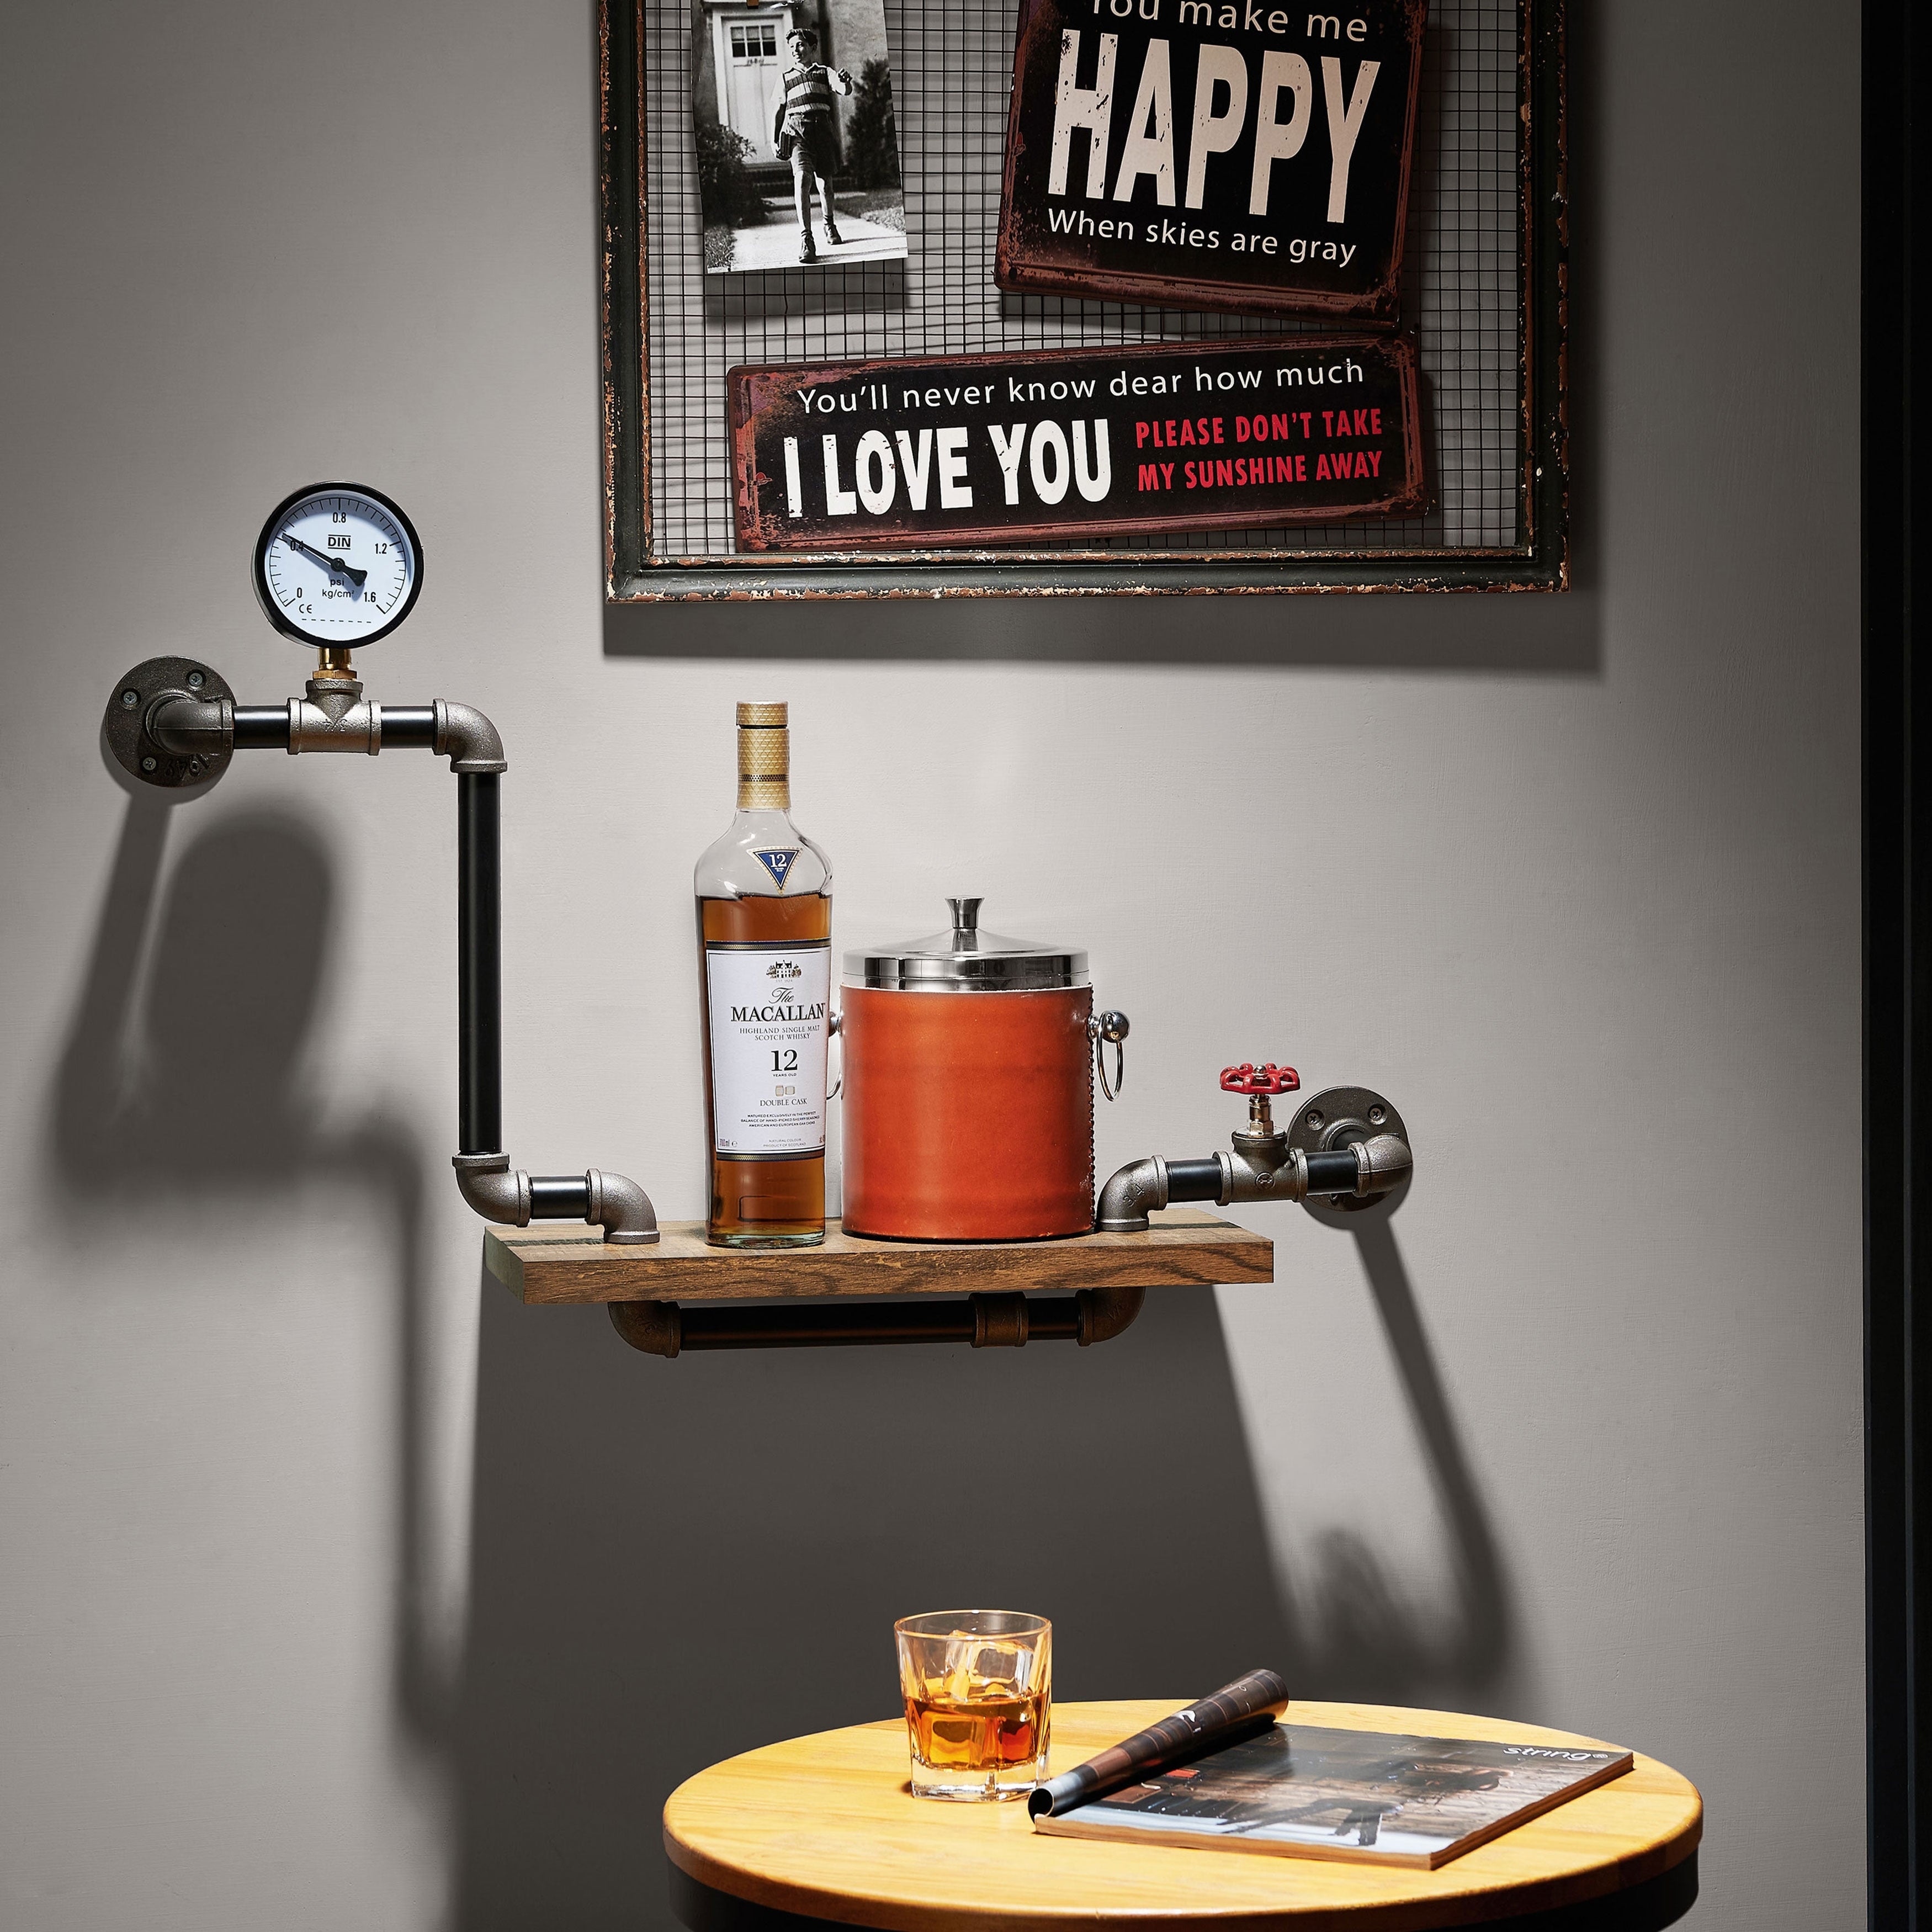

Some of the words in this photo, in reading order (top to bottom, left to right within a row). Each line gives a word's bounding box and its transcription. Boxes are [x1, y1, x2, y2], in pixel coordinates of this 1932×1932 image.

[1180, 0, 1287, 33] make
[1308, 15, 1366, 41] me
[1048, 29, 1381, 223] HAPPY
[1049, 209, 1133, 240] When
[1146, 219, 1219, 248] skies
[1232, 233, 1277, 253] are
[1290, 240, 1356, 267] gray
[797, 383, 888, 413] You'll
[904, 385, 994, 408] never
[1009, 378, 1095, 401] know
[1110, 371, 1181, 396] dear
[1196, 367, 1262, 391] how
[1277, 358, 1362, 386] much
[1136, 418, 1224, 448] PLEASE
[1323, 409, 1381, 437] TAKE
[784, 437, 802, 518] I
[822, 427, 973, 516] LOVE
[988, 419, 1111, 505] YOU
[1139, 463, 1174, 491] MY
[1185, 455, 1306, 489] SUNSHINE
[1317, 452, 1381, 480] AWAY
[332, 512, 347, 523] 0.8
[328, 537, 351, 548] DIN
[375, 543, 387, 554] 1.2
[296, 587, 302, 598] 0
[364, 592, 376, 603] 1.6
[769, 853, 787, 868] 12
[768, 987, 794, 1004] The
[730, 1002, 826, 1023] MACALLAN
[771, 1049, 798, 1071] 12
